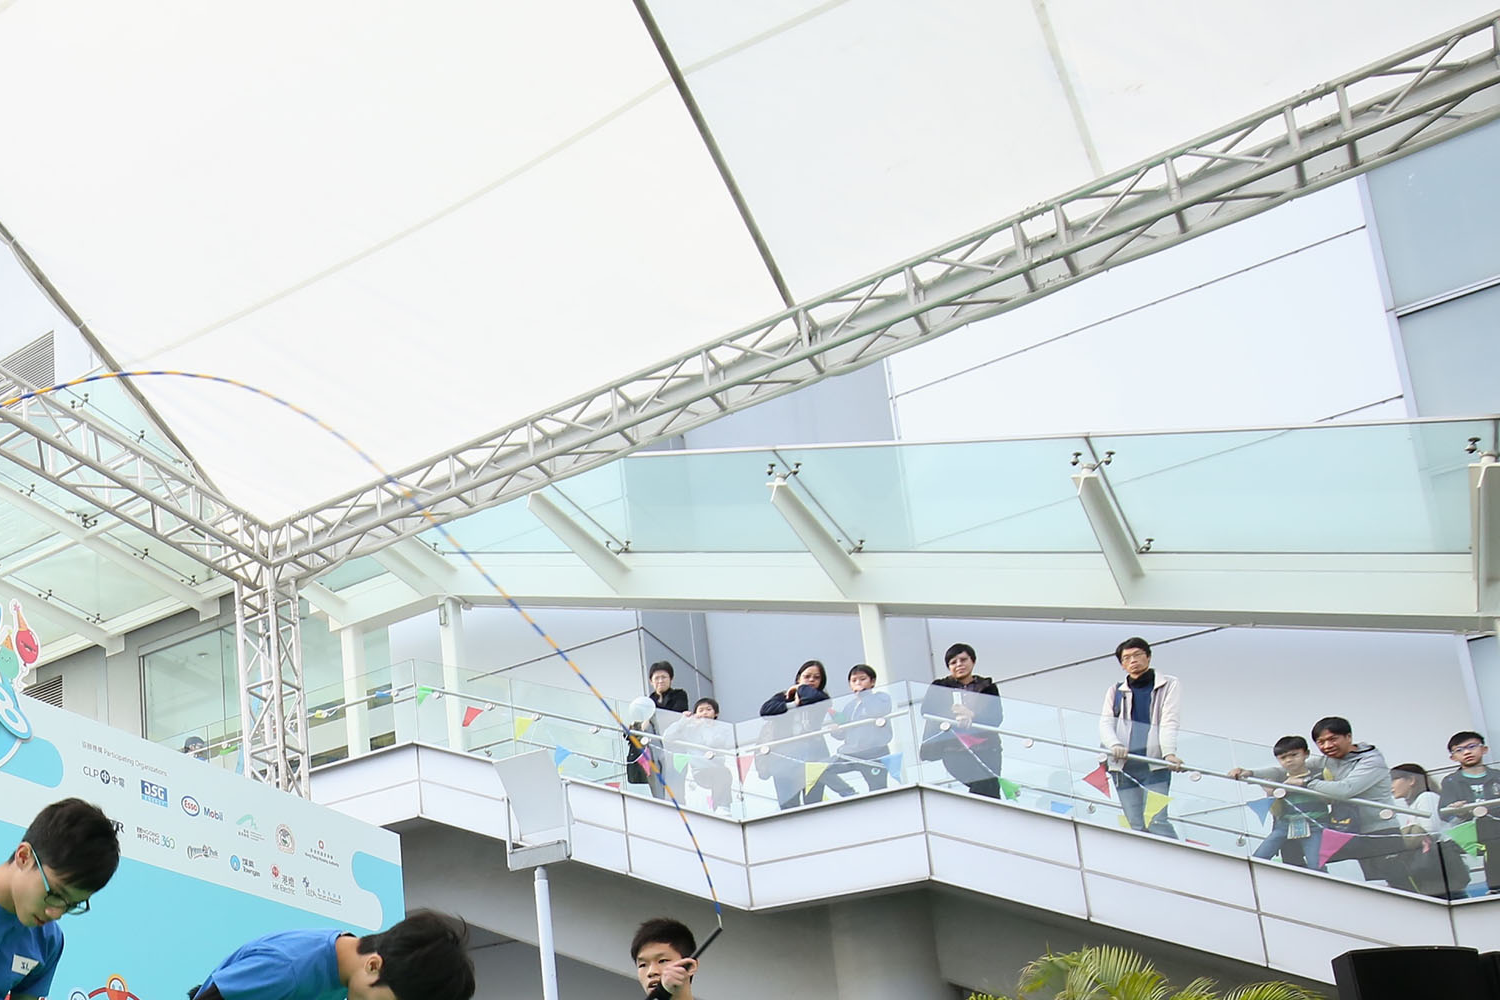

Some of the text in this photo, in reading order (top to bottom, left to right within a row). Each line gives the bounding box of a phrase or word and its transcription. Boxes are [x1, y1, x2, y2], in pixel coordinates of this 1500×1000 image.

[83, 766, 99, 778] CLP
[144, 783, 165, 799] DSG
[204, 807, 223, 821] Mobil
[161, 835, 175, 849] 360
